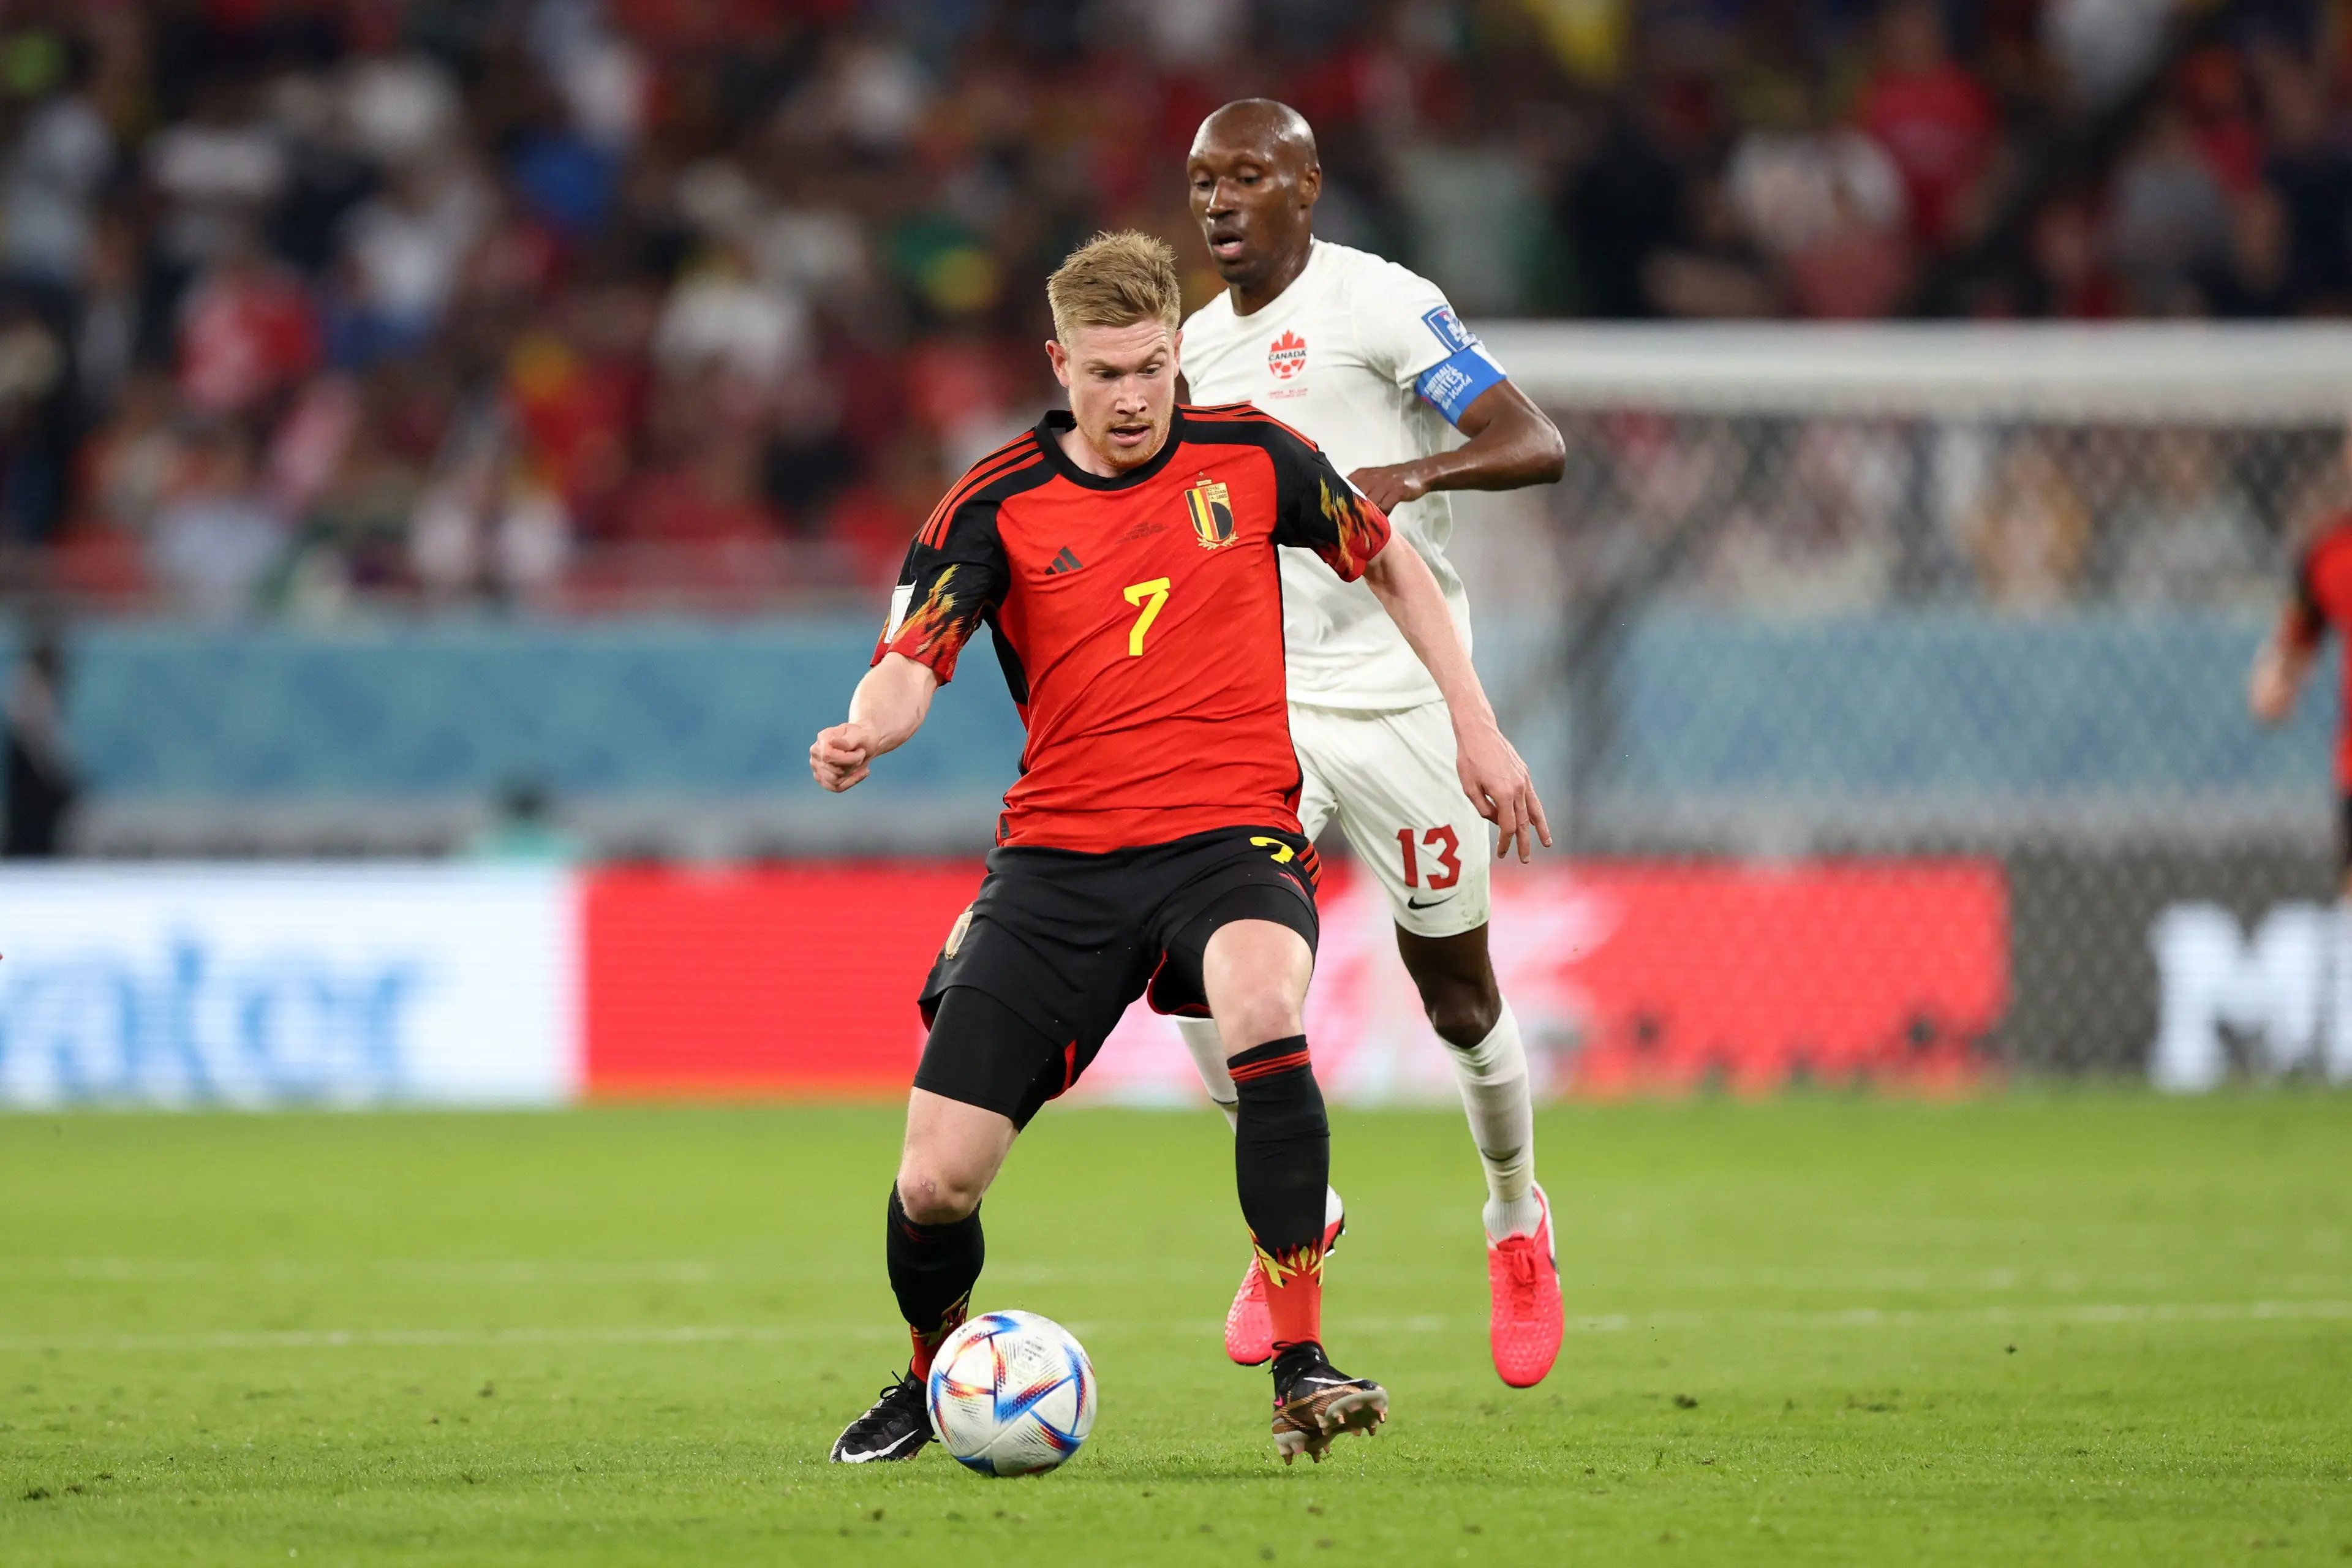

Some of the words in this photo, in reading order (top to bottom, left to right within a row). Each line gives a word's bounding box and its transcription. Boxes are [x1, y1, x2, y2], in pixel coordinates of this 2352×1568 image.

[1268, 350, 1306, 361] CANADA
[1123, 576, 1170, 656] 7
[1396, 824, 1461, 890] 13
